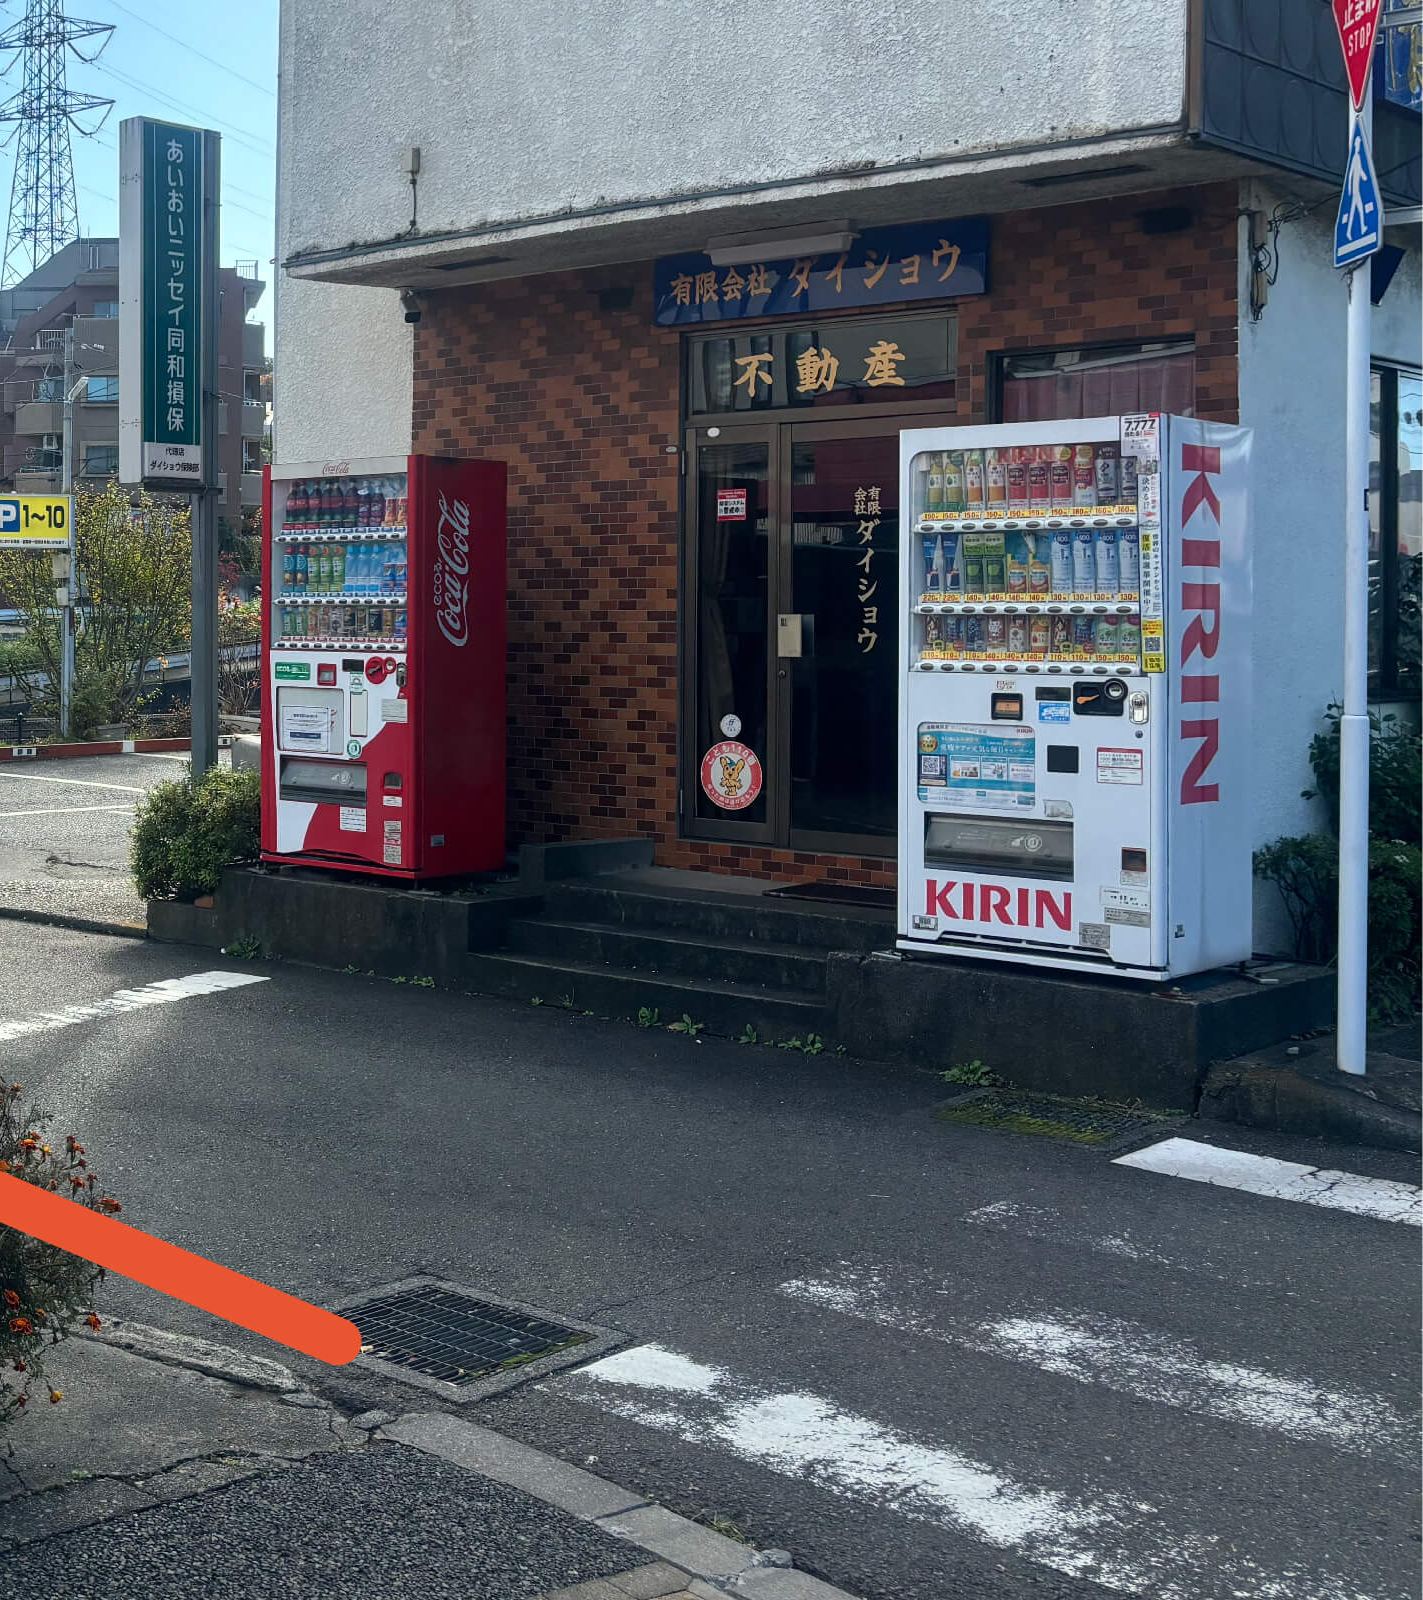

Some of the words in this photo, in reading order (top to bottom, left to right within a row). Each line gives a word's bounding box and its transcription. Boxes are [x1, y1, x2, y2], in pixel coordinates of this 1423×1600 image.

[1348, 22, 1371, 57] STOP
[166, 138, 186, 432] あいおいニッセイ同和損保
[670, 263, 773, 306] 有限会社
[787, 238, 961, 298] ダイショウ
[733, 340, 906, 398] 不動産
[150, 459, 200, 472] ダイショウ保険部
[165, 446, 185, 456] 代理店
[854, 486, 882, 516] 有限会社
[436, 487, 470, 647] Coca-Cola
[856, 518, 882, 653] ダイショウ
[1180, 443, 1221, 805] KIRIN
[926, 879, 1073, 932] KIRIN
